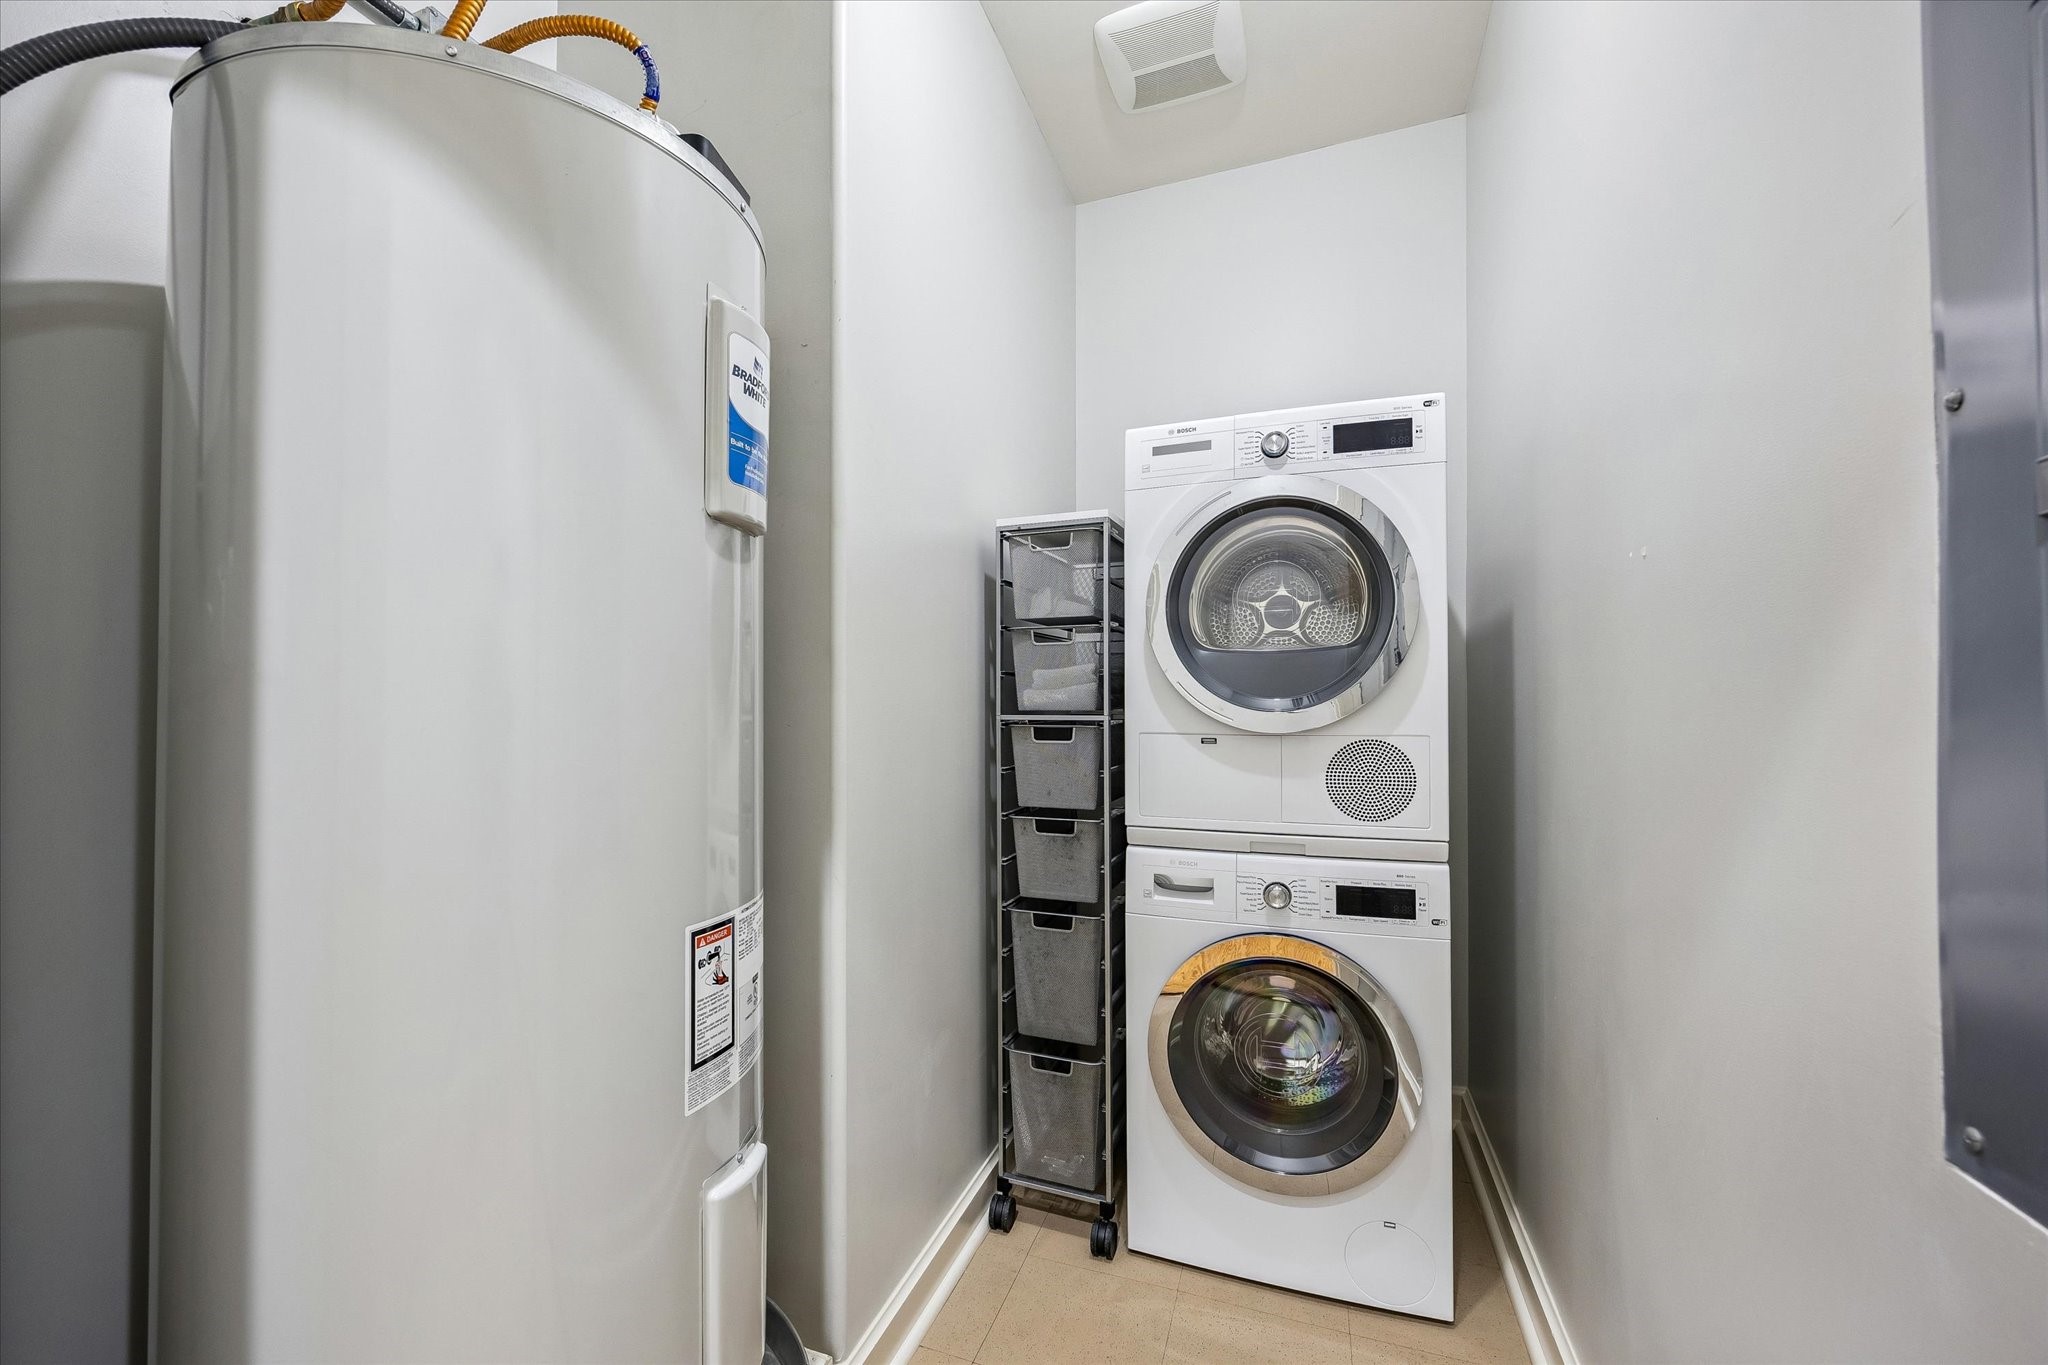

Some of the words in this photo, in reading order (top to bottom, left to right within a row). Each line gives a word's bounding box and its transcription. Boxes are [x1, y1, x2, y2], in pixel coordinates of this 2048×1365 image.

[731, 363, 769, 400] BRADFO
[743, 382, 767, 409] WHITE
[706, 929, 728, 943] DANGER
